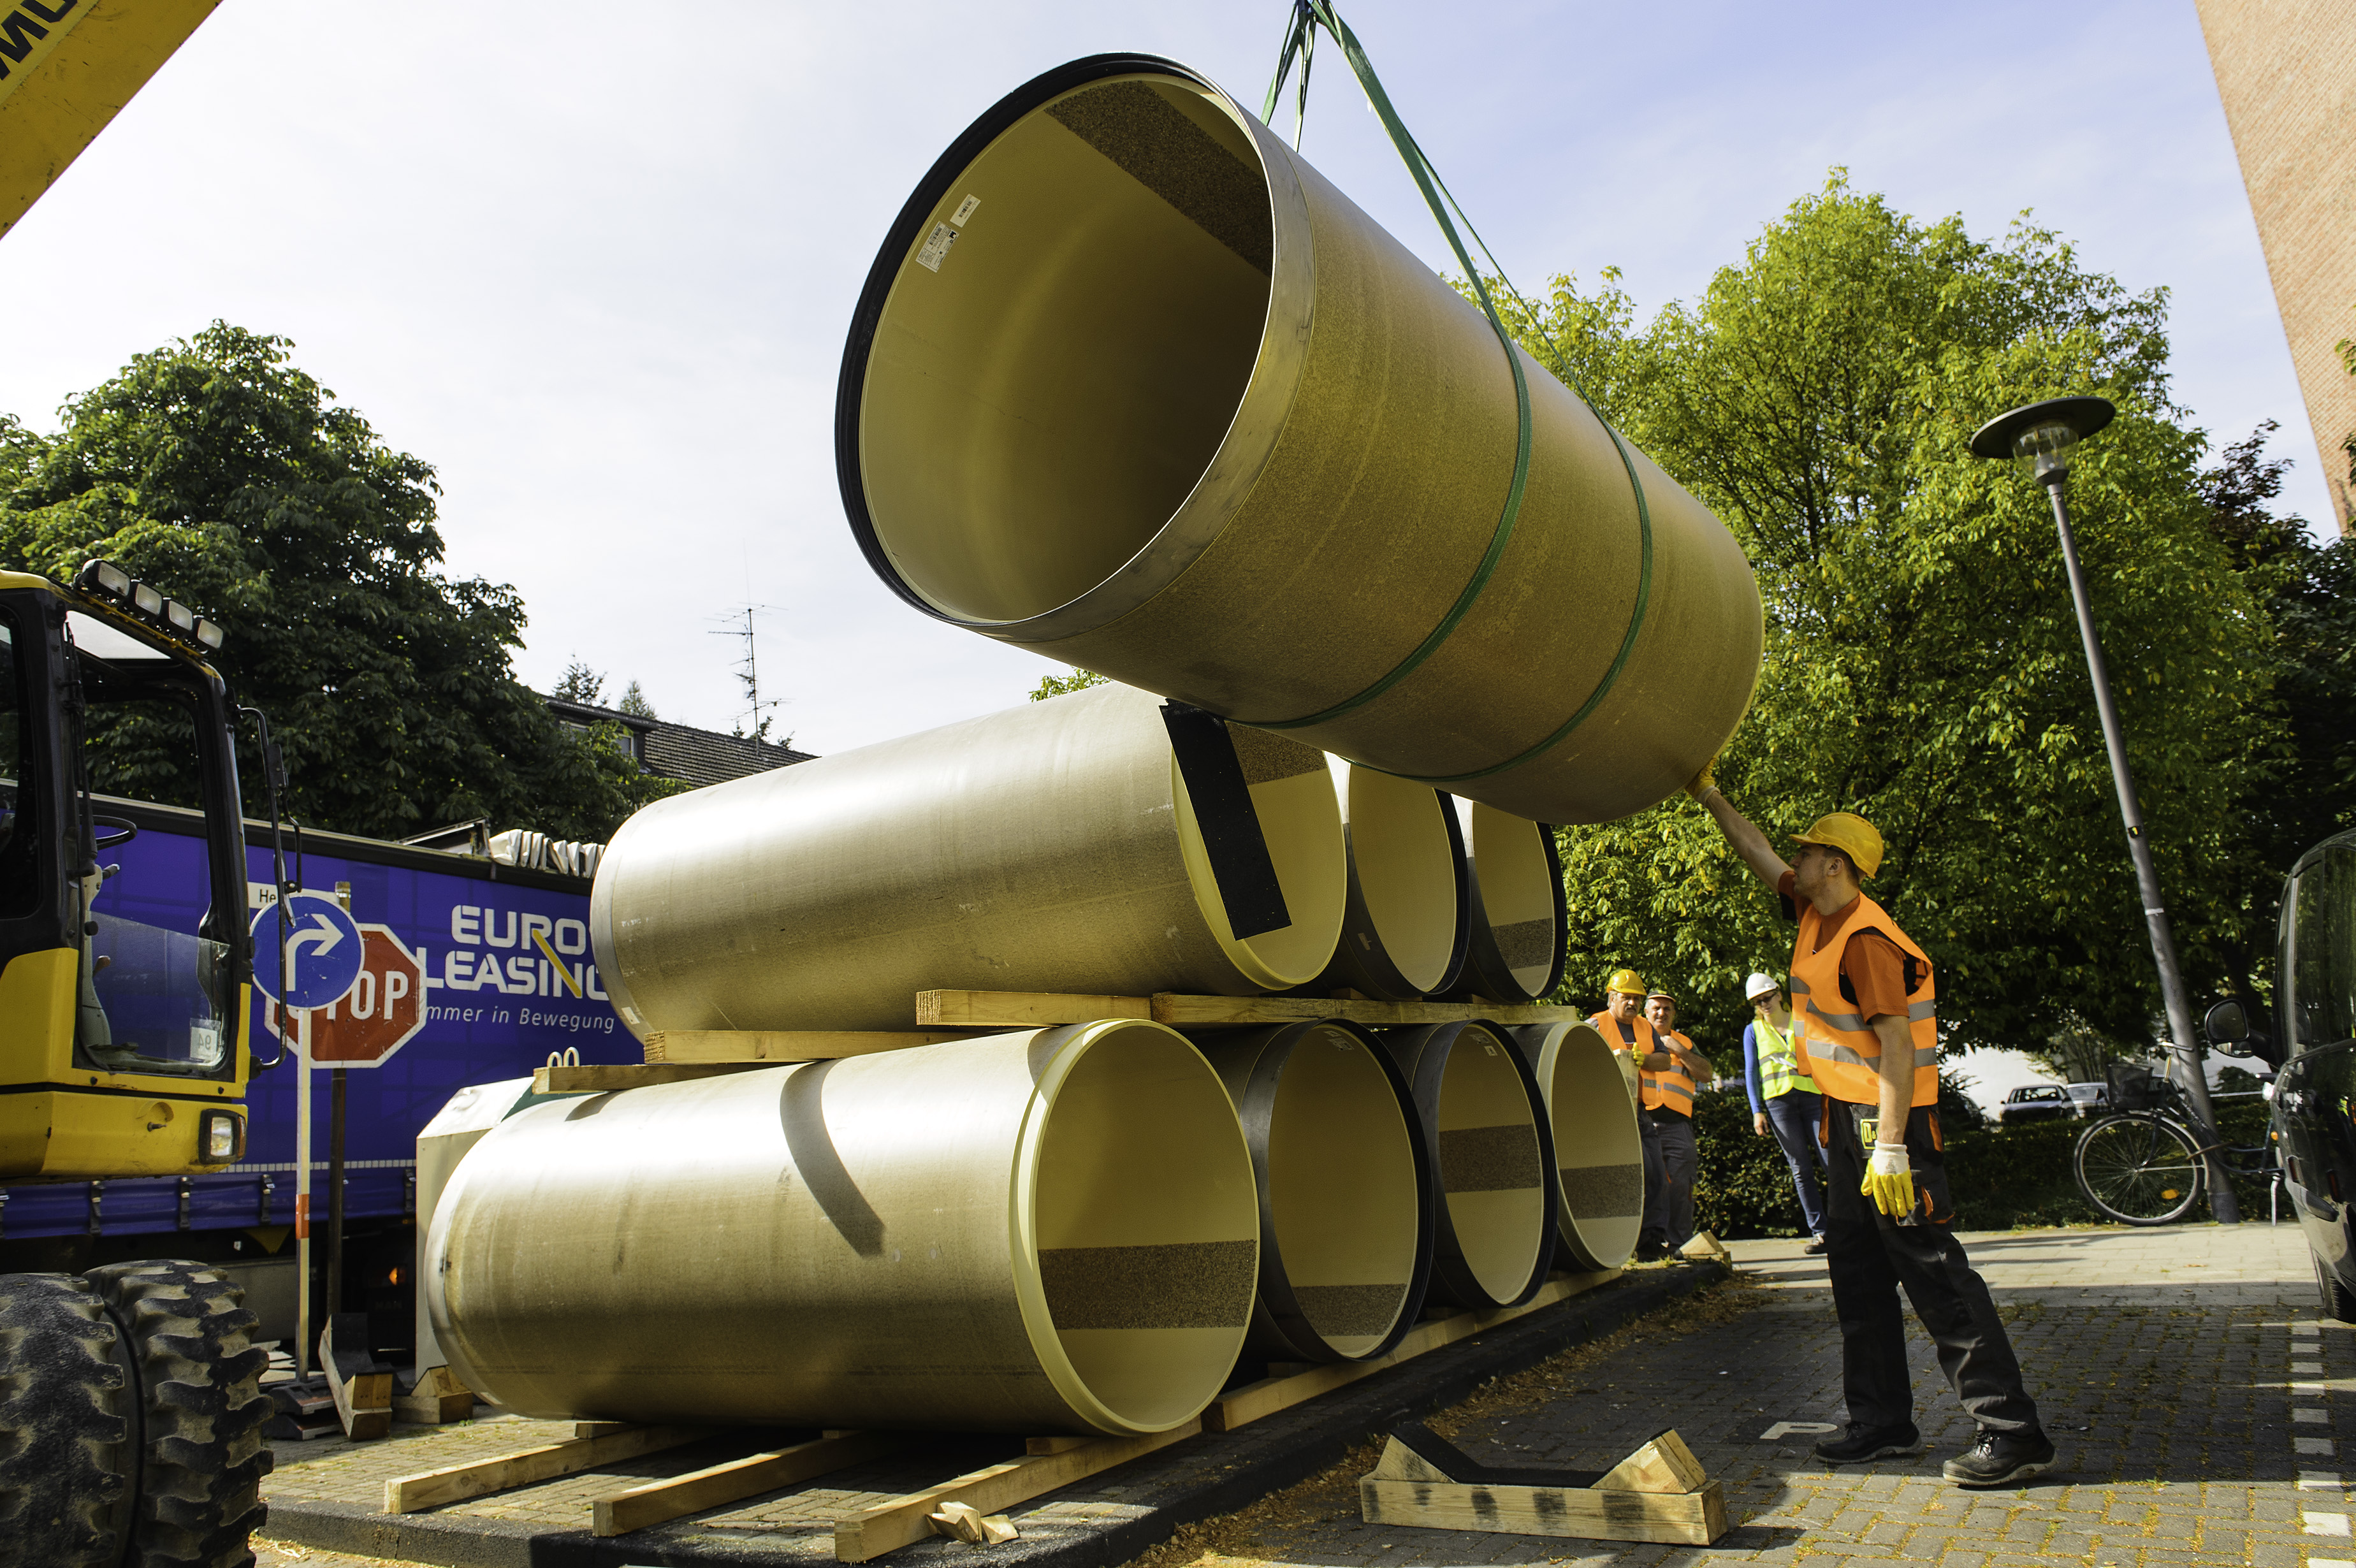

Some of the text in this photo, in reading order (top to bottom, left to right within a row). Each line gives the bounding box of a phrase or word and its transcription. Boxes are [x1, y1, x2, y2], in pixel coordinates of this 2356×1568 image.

[451, 904, 586, 955] EURO
[287, 970, 409, 1020] OP
[492, 1005, 510, 1024] in
[520, 1008, 615, 1034] Bewegung
[1759, 1421, 1838, 1439] P
